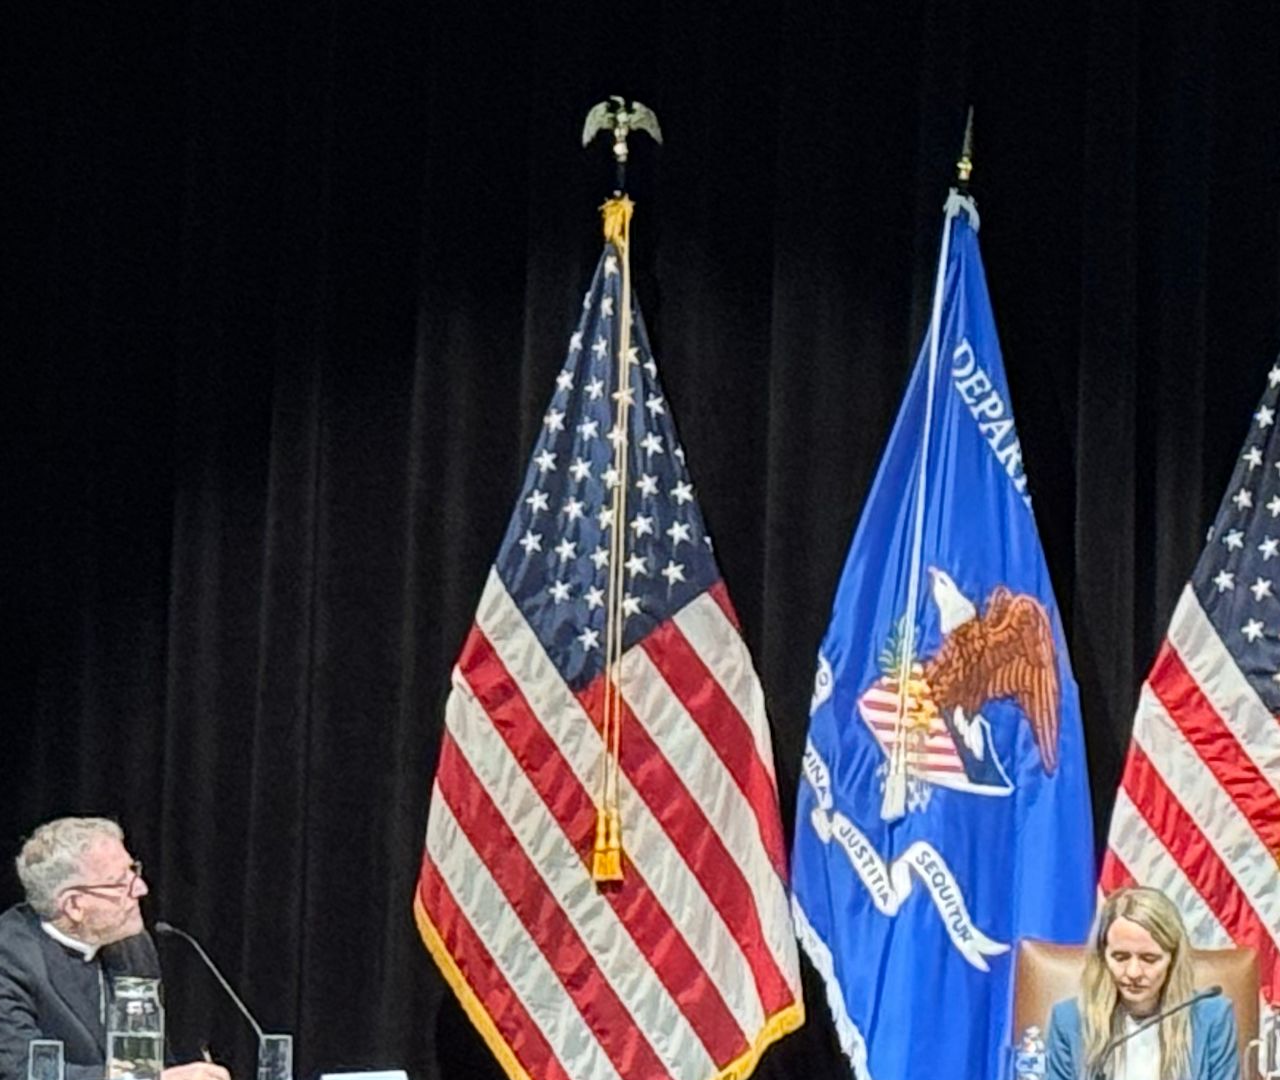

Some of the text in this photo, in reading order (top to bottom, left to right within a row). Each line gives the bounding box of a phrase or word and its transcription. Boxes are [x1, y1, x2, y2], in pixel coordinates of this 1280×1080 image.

[951, 336, 1033, 509] DEPAR
[838, 824, 890, 907] JUSTITIA
[914, 849, 975, 944] SEQUITUR
